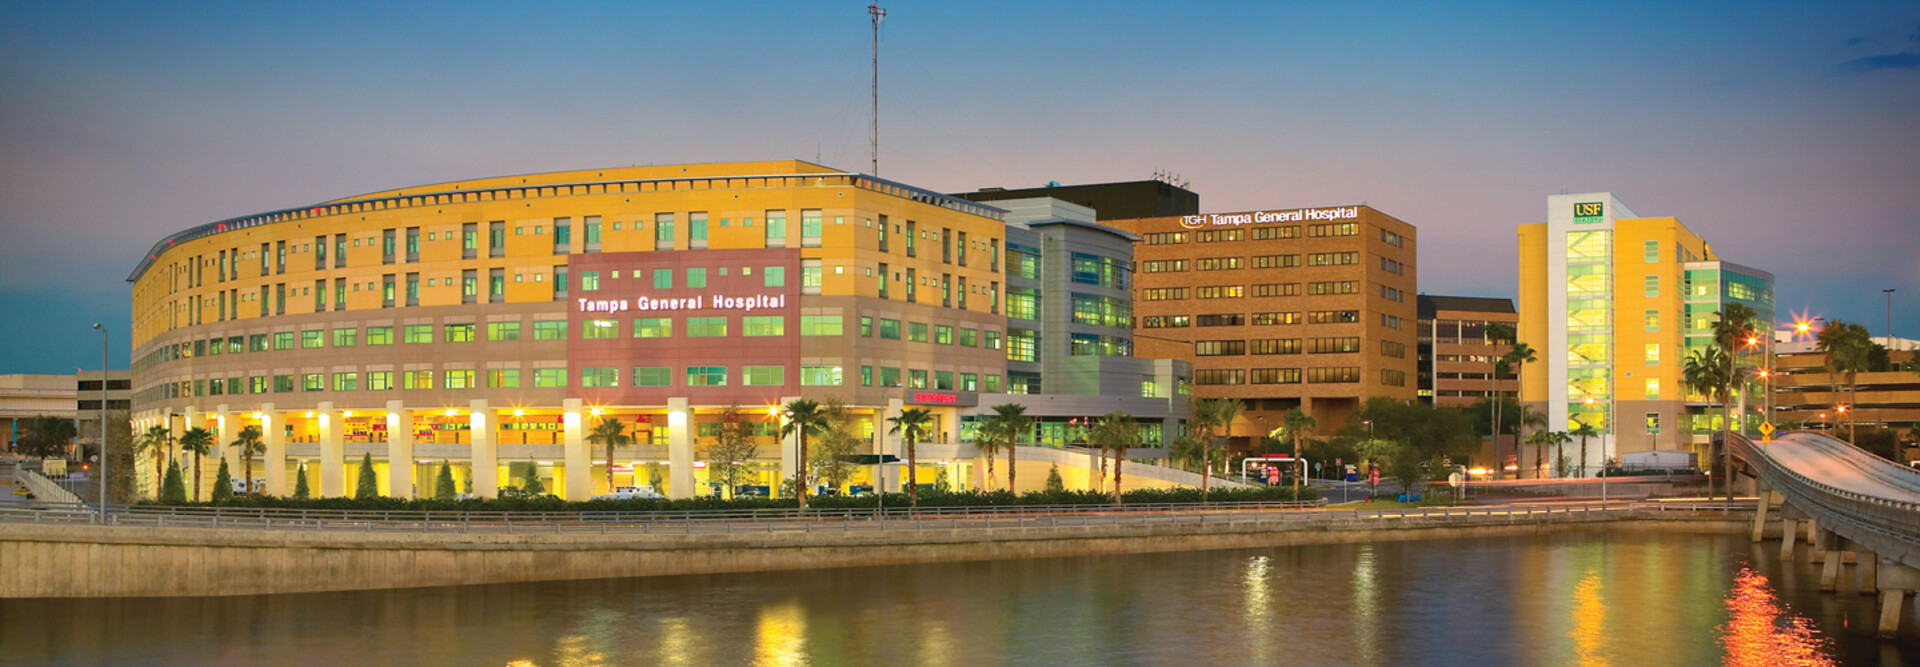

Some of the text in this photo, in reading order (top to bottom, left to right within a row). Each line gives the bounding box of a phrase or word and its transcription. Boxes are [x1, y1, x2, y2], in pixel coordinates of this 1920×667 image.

[1183, 207, 1358, 226] TGH Tampa General Hospital
[1576, 203, 1601, 216] USF
[578, 294, 786, 314] Tampa General Hospital
